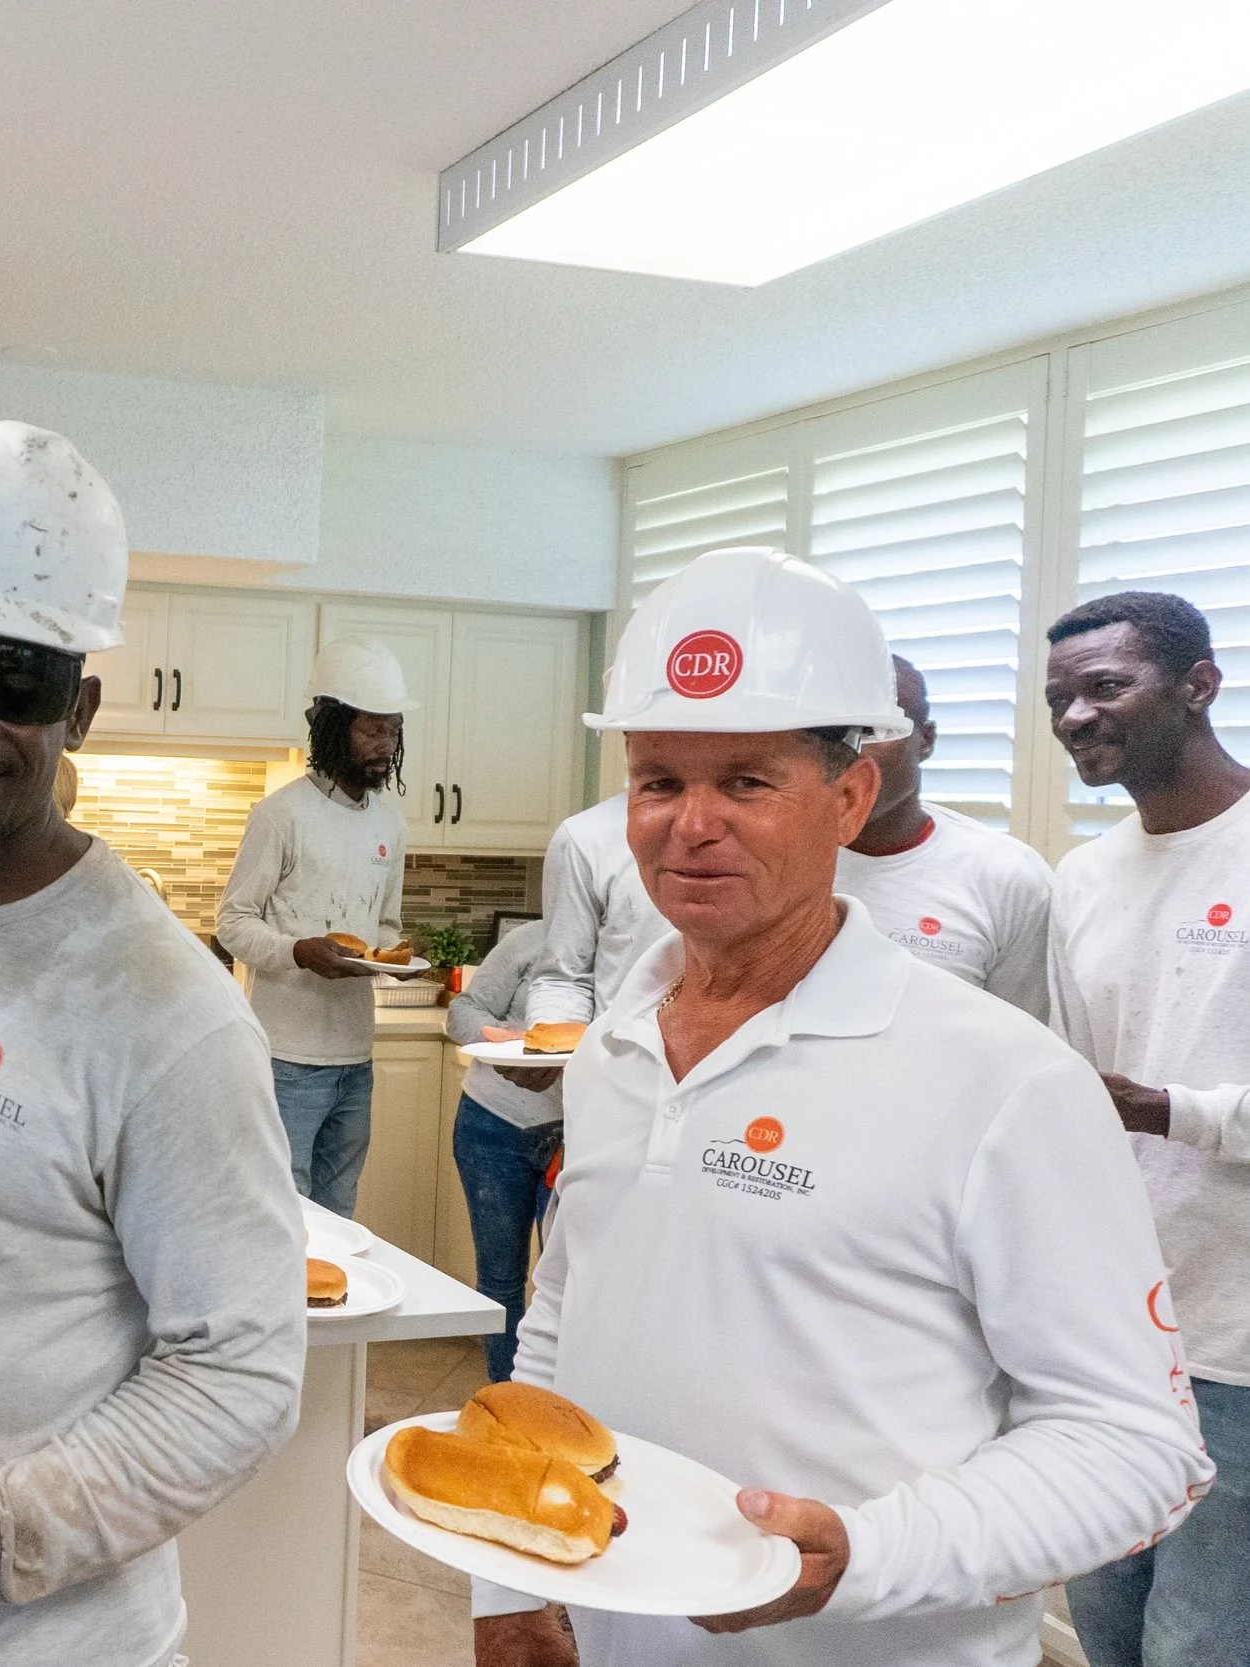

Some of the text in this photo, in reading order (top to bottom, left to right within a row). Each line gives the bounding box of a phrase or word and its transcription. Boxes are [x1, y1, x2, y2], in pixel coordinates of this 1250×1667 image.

[674, 652, 731, 677] CDR
[888, 931, 964, 953] CAROUSEL
[1176, 927, 1249, 944] CAROUSEL
[748, 1127, 779, 1143] CDR
[702, 1148, 816, 1190] CAROUSEL
[716, 1178, 783, 1200] CGC# 1524205
